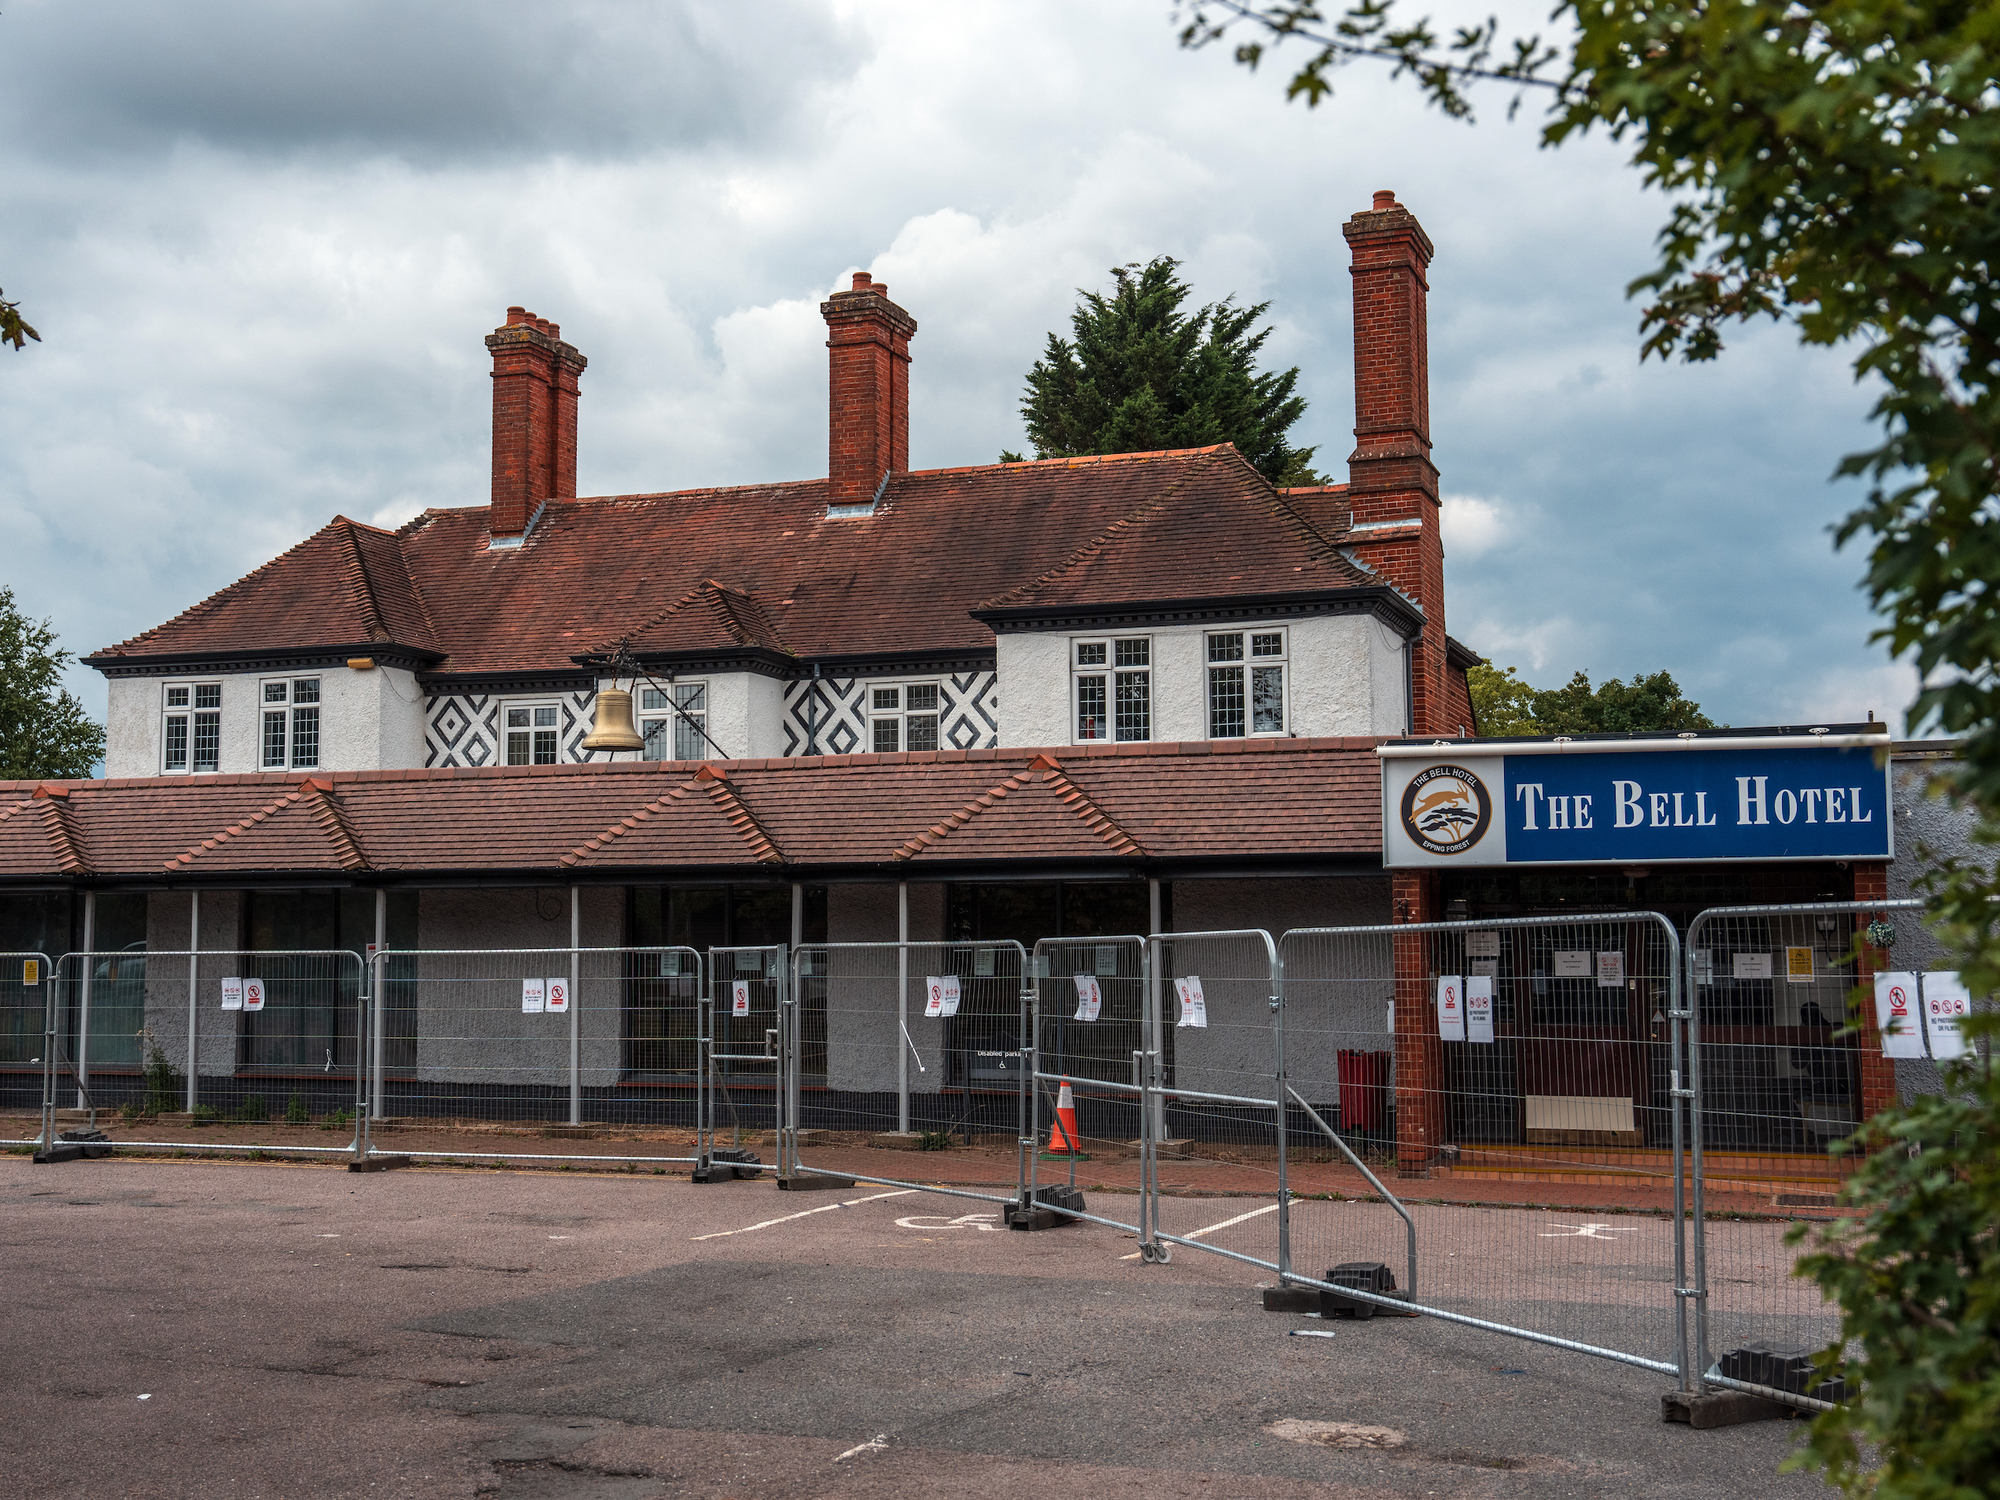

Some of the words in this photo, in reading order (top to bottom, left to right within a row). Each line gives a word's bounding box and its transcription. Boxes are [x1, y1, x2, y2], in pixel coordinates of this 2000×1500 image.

[1412, 773, 1430, 788] THE
[1430, 767, 1451, 778] BELL
[1452, 768, 1478, 788] HOTEL
[1515, 783, 1593, 830] THE
[1611, 780, 1716, 828] BELL
[1734, 776, 1872, 824] HOTEL
[1422, 840, 1445, 853] EPPING
[1446, 839, 1470, 853] FOREST
